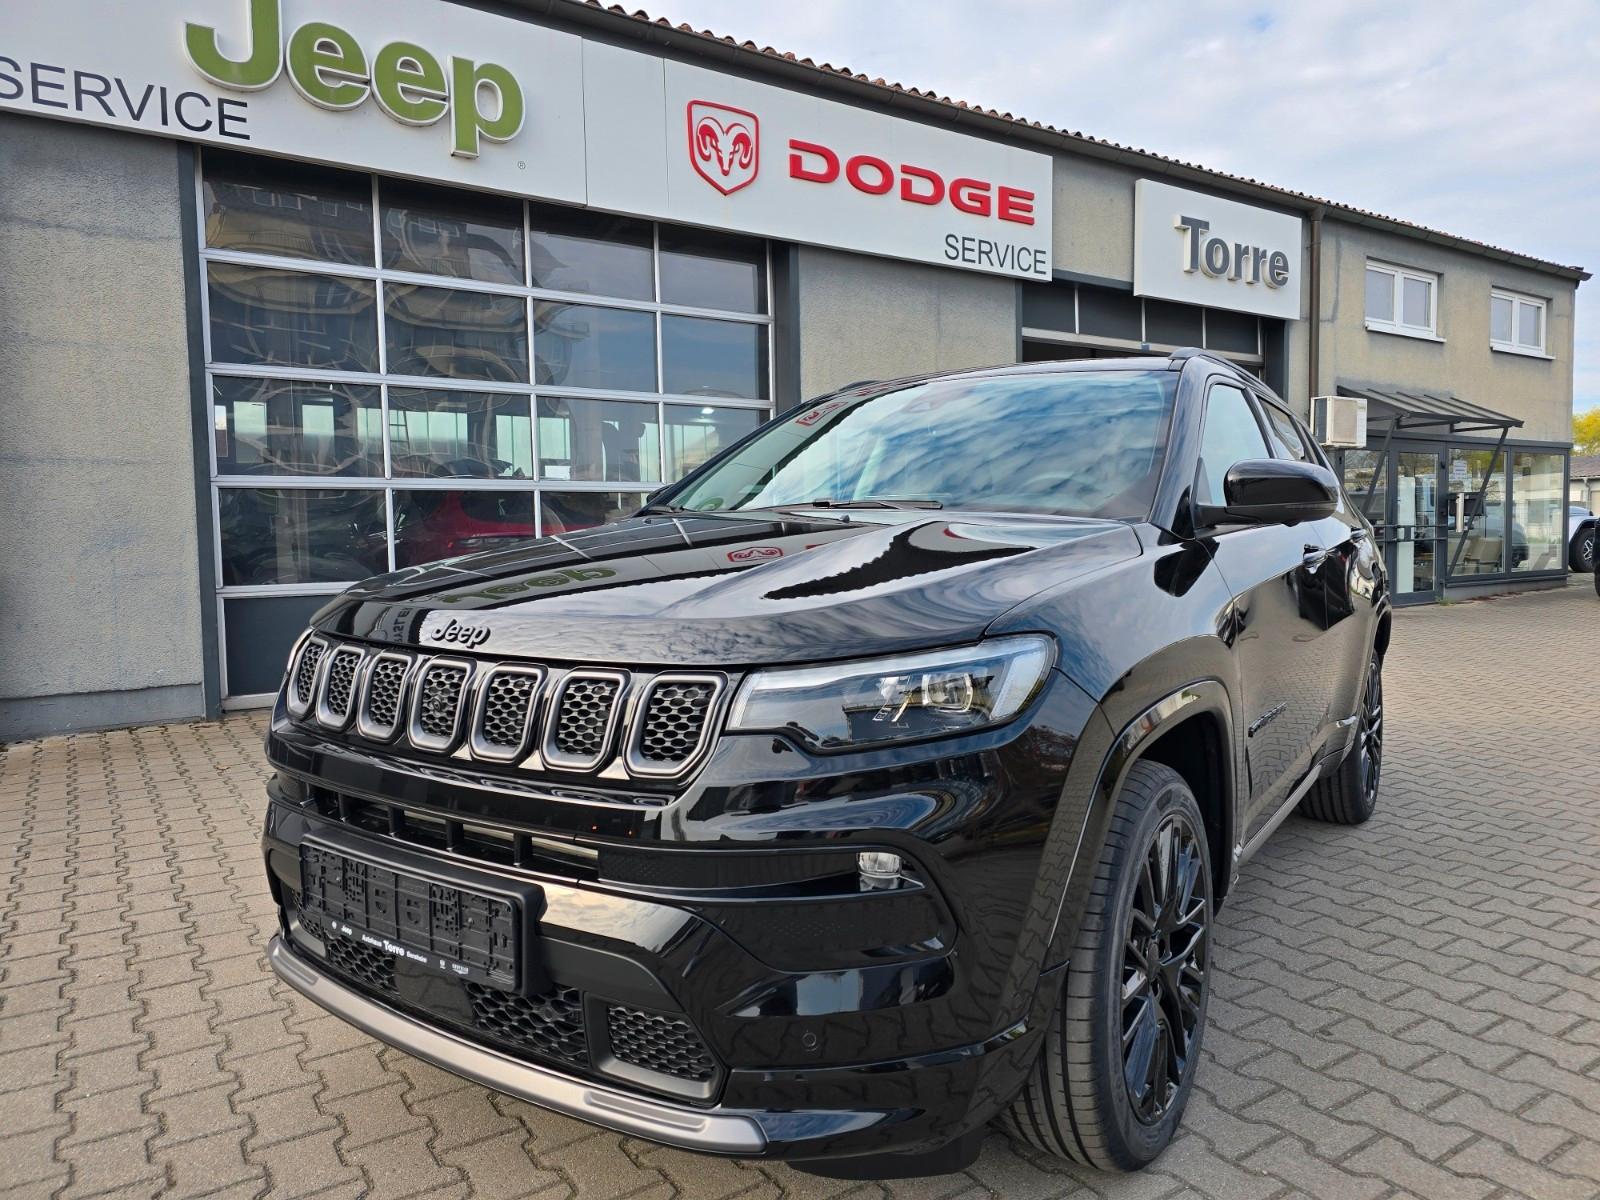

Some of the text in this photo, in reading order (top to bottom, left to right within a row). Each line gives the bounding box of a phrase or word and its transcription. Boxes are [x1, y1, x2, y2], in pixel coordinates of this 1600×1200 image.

[0, 56, 251, 140] SERVICE
[182, 0, 526, 159] Jeep
[789, 139, 1035, 226] DODGE
[944, 233, 1047, 275] SERVICE
[1174, 215, 1290, 289] Torre
[431, 619, 491, 649] Jeep
[383, 939, 405, 956] Torre
